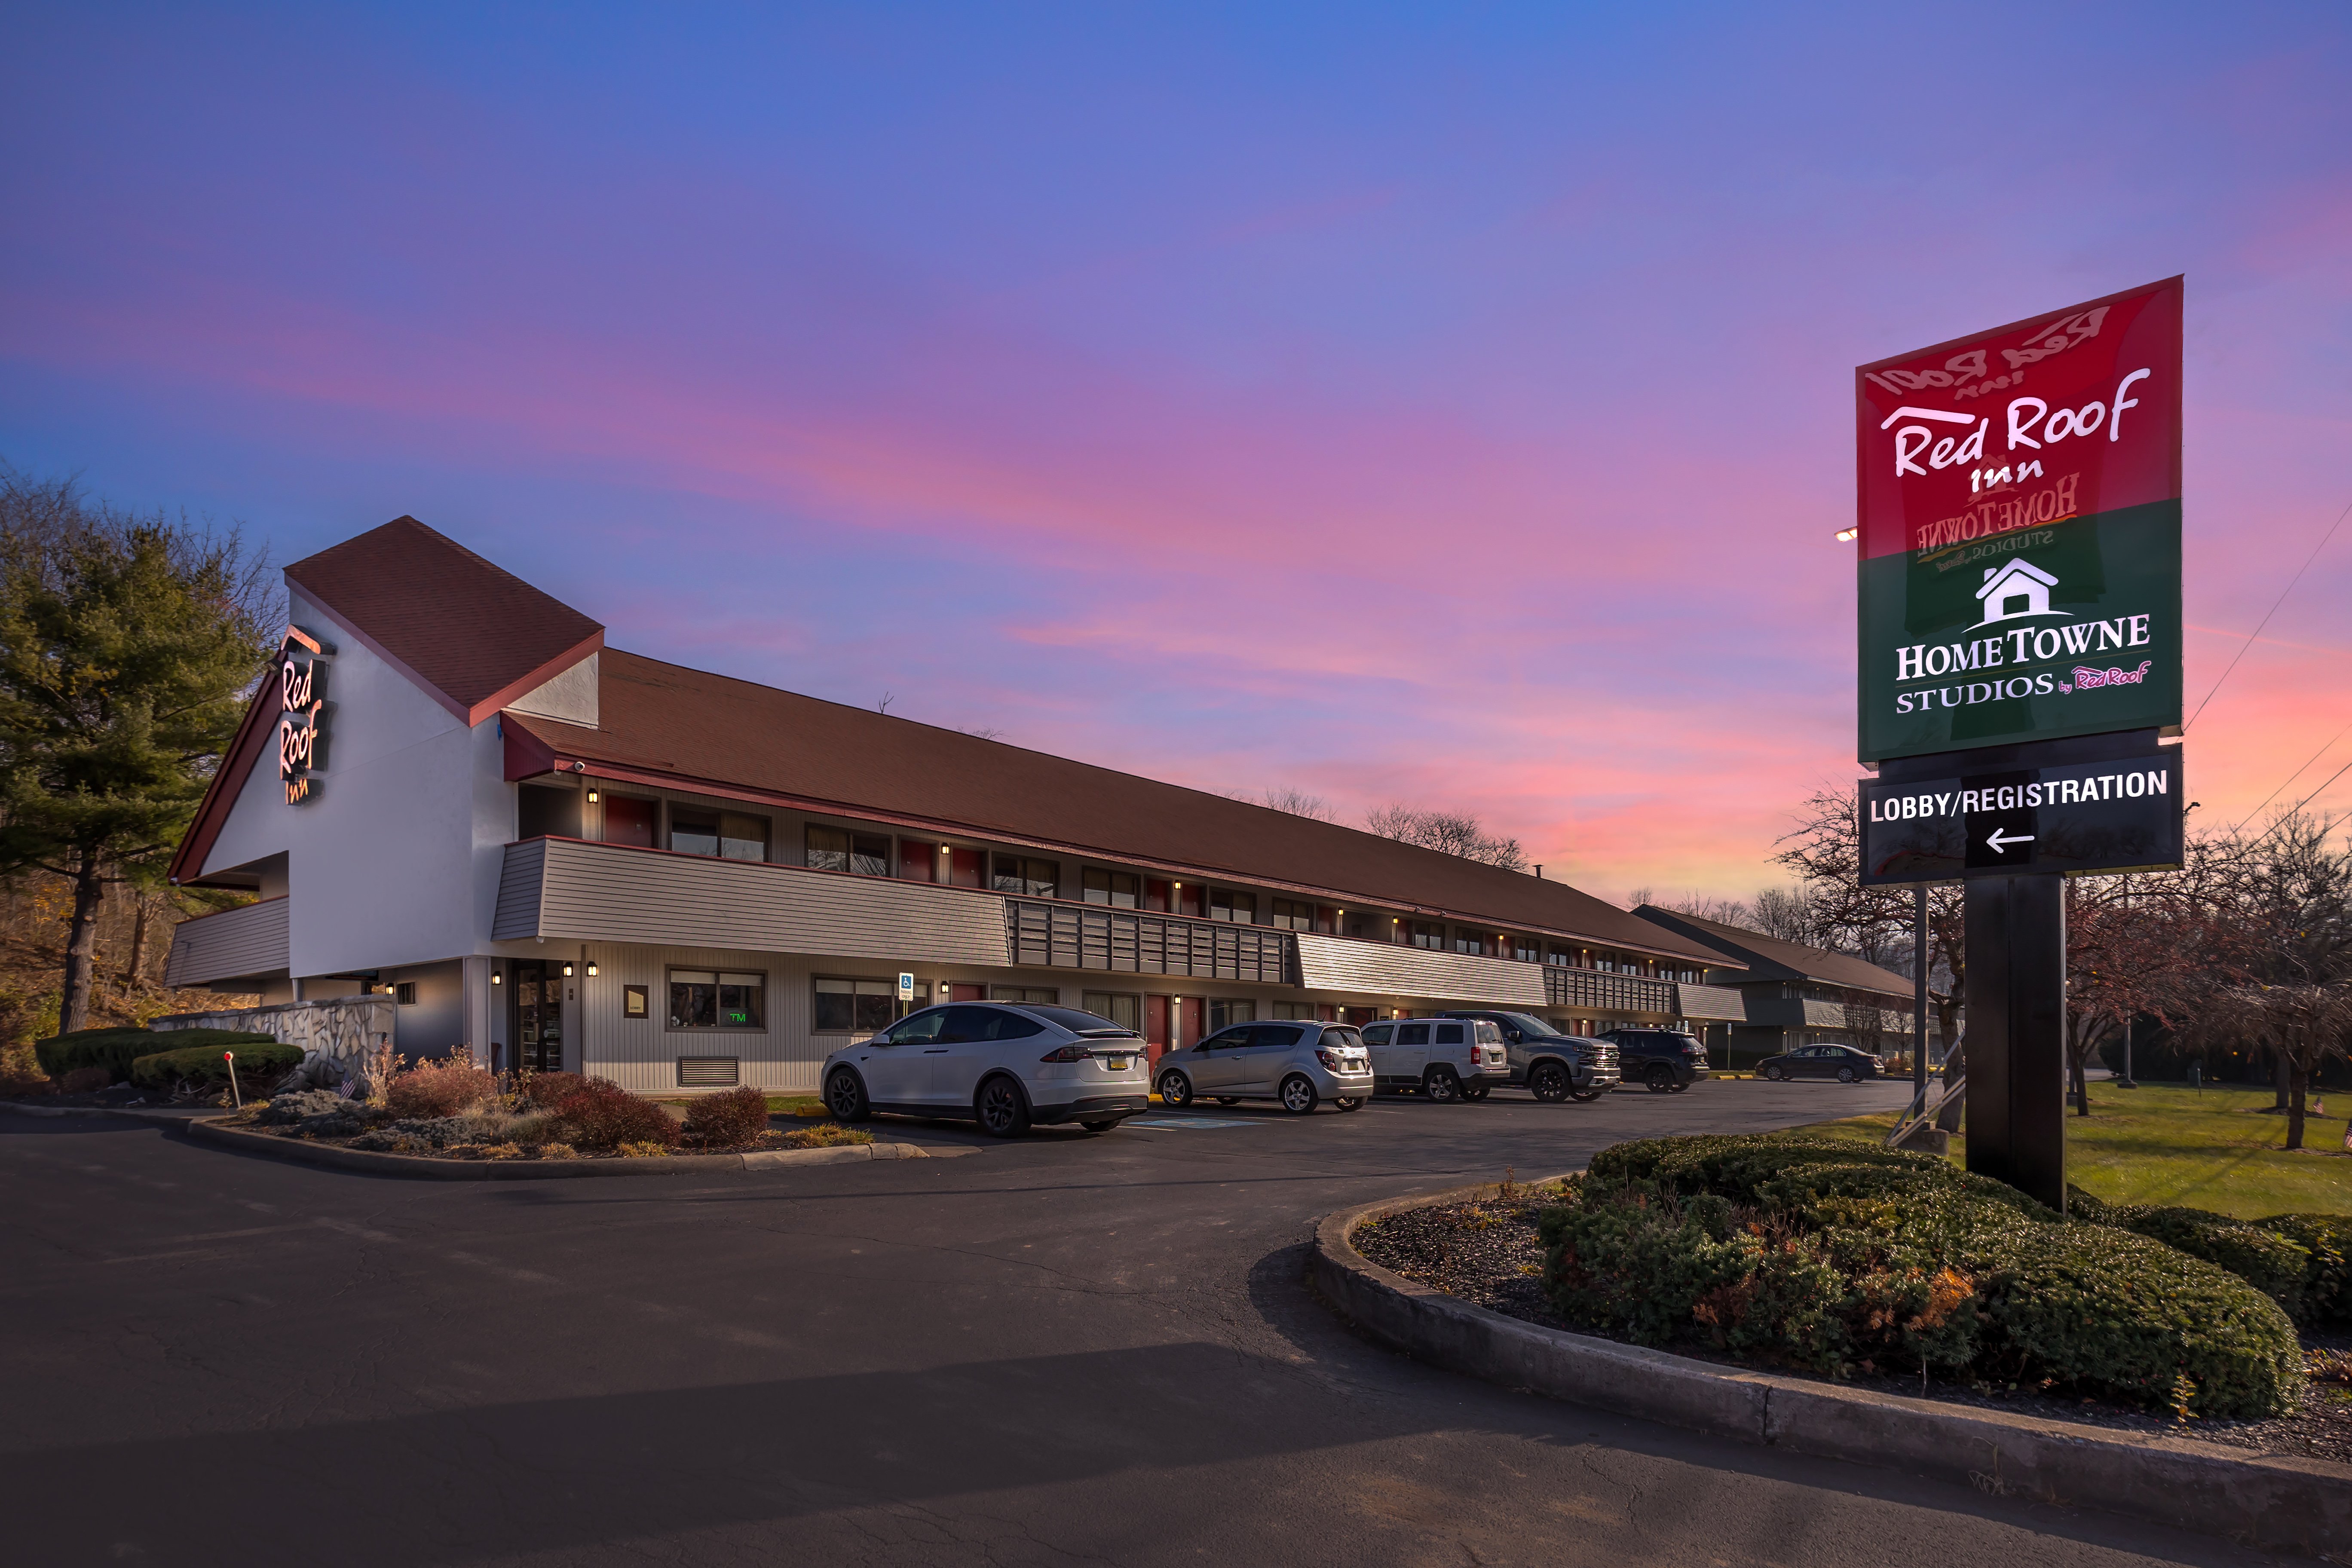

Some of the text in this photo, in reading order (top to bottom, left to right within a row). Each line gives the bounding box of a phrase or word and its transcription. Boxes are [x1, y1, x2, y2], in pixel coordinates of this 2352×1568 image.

[1895, 368, 2151, 477] Red Roof
[282, 659, 312, 712] Red
[1896, 674, 2053, 714] STUDIOS
[2059, 681, 2072, 695] by
[280, 699, 322, 781] Roof
[1871, 770, 2167, 822] LOBBY/REGISTRATION
